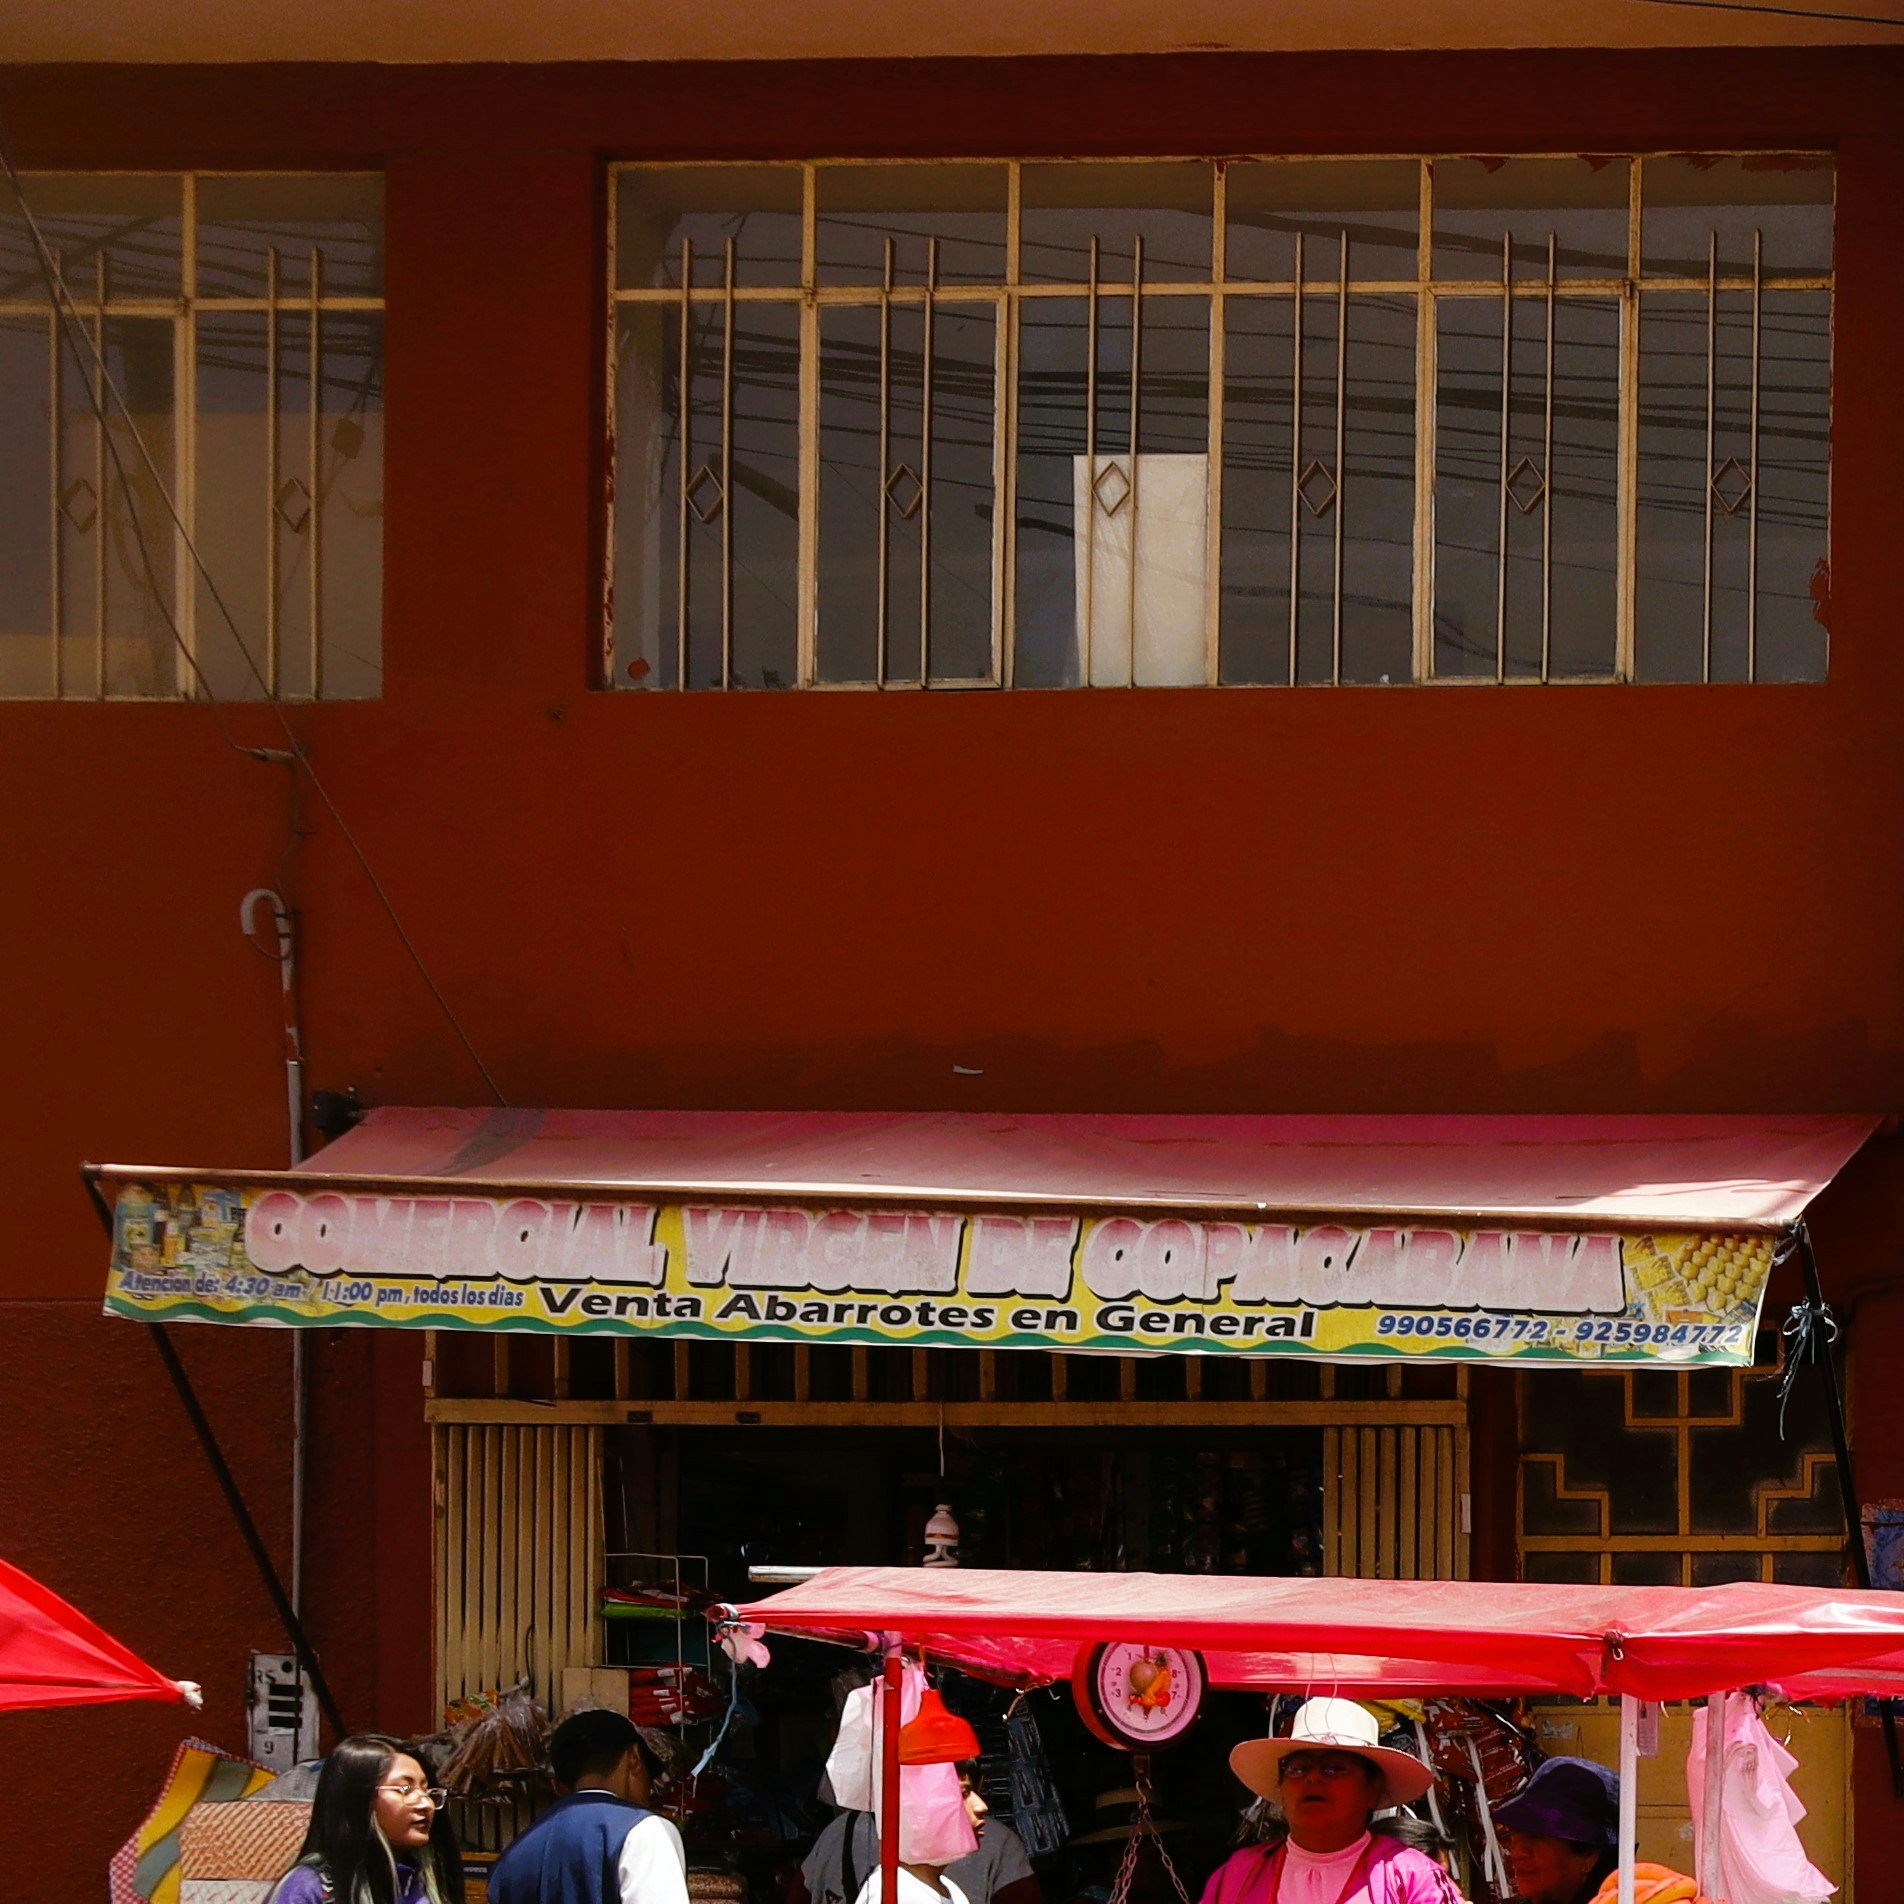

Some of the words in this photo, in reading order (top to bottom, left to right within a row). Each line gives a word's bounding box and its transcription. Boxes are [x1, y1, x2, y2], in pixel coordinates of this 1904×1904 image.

[245, 1192, 669, 1286] COMERCIAL
[682, 1203, 967, 1293] VIRGEN
[966, 1214, 1083, 1301] DE
[1081, 1216, 1624, 1313] COPACABANA
[195, 1274, 219, 1295] de:
[224, 1278, 269, 1297] 4:30
[272, 1281, 299, 1299] am
[376, 1286, 410, 1307] pm,
[413, 1283, 459, 1304] todos
[461, 1283, 487, 1304] los
[489, 1284, 523, 1307] dias
[538, 1285, 706, 1320] Venta
[714, 1292, 997, 1332] Abarrotes
[1010, 1308, 1081, 1330] en
[1094, 1304, 1316, 1341] General
[1376, 1314, 1548, 1342] 990566772
[1574, 1320, 1745, 1346] 925984772
[1116, 1667, 1121, 1676] 2
[1116, 1689, 1121, 1697] 3
[1172, 1691, 1177, 1699] 7
